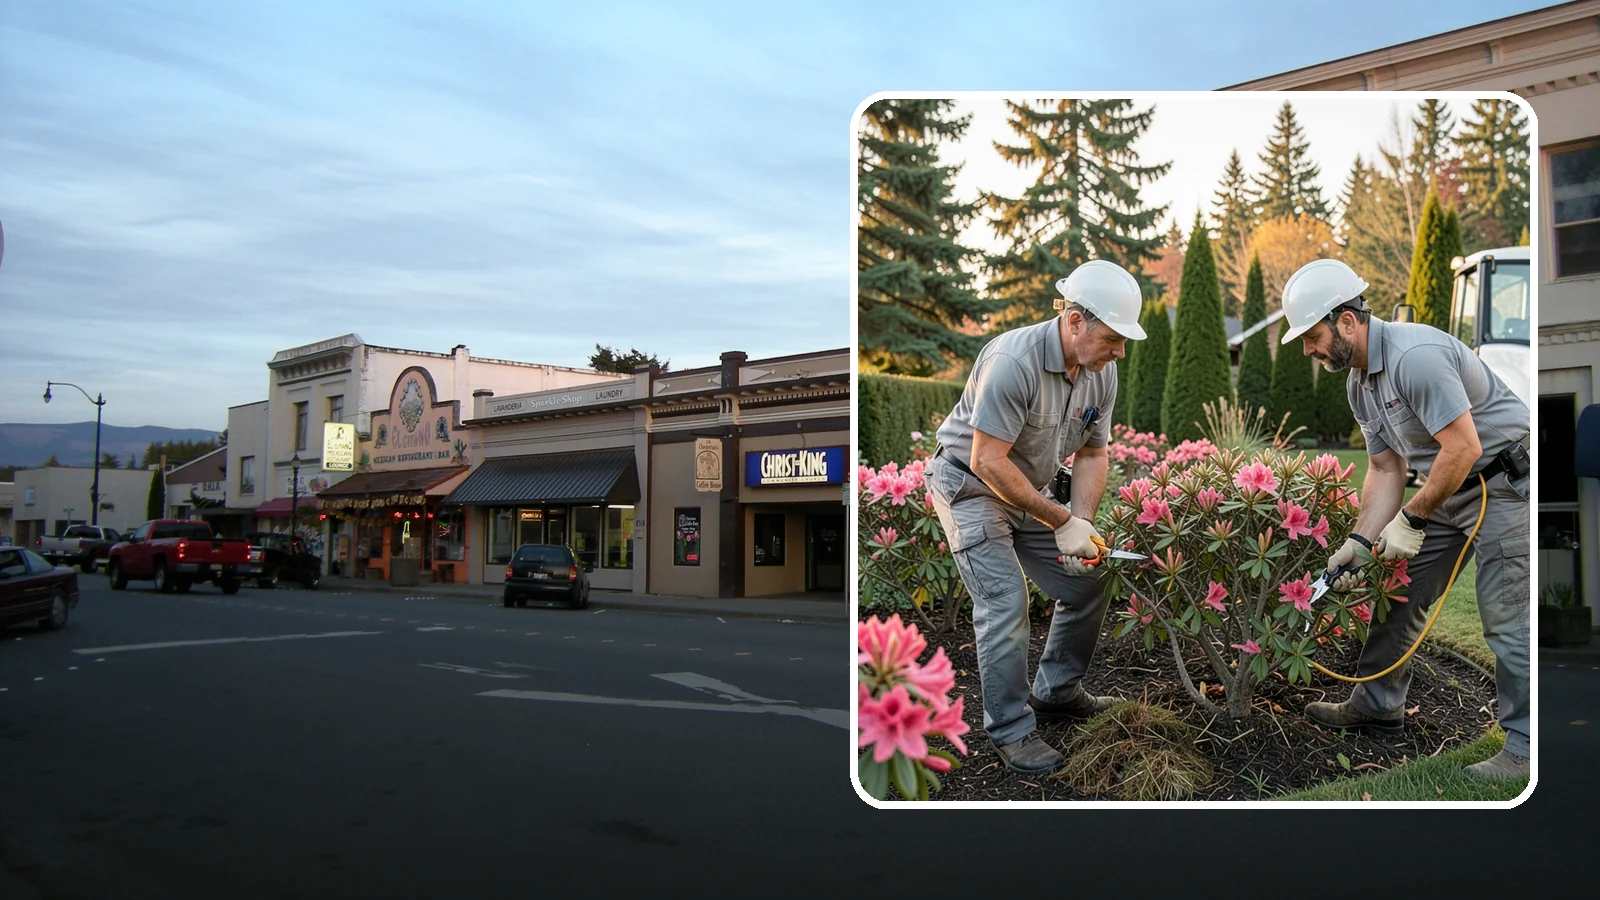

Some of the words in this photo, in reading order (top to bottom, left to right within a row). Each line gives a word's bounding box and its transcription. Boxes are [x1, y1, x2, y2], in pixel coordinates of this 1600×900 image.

[493, 402, 522, 413] LAVANDERIA
[595, 390, 624, 400] LAUNDRY
[374, 454, 396, 464] MEXICAN
[397, 451, 433, 462] RESTAURANT
[438, 450, 450, 459] BAR
[761, 452, 797, 478] CHRIST
[799, 450, 827, 476] KING
